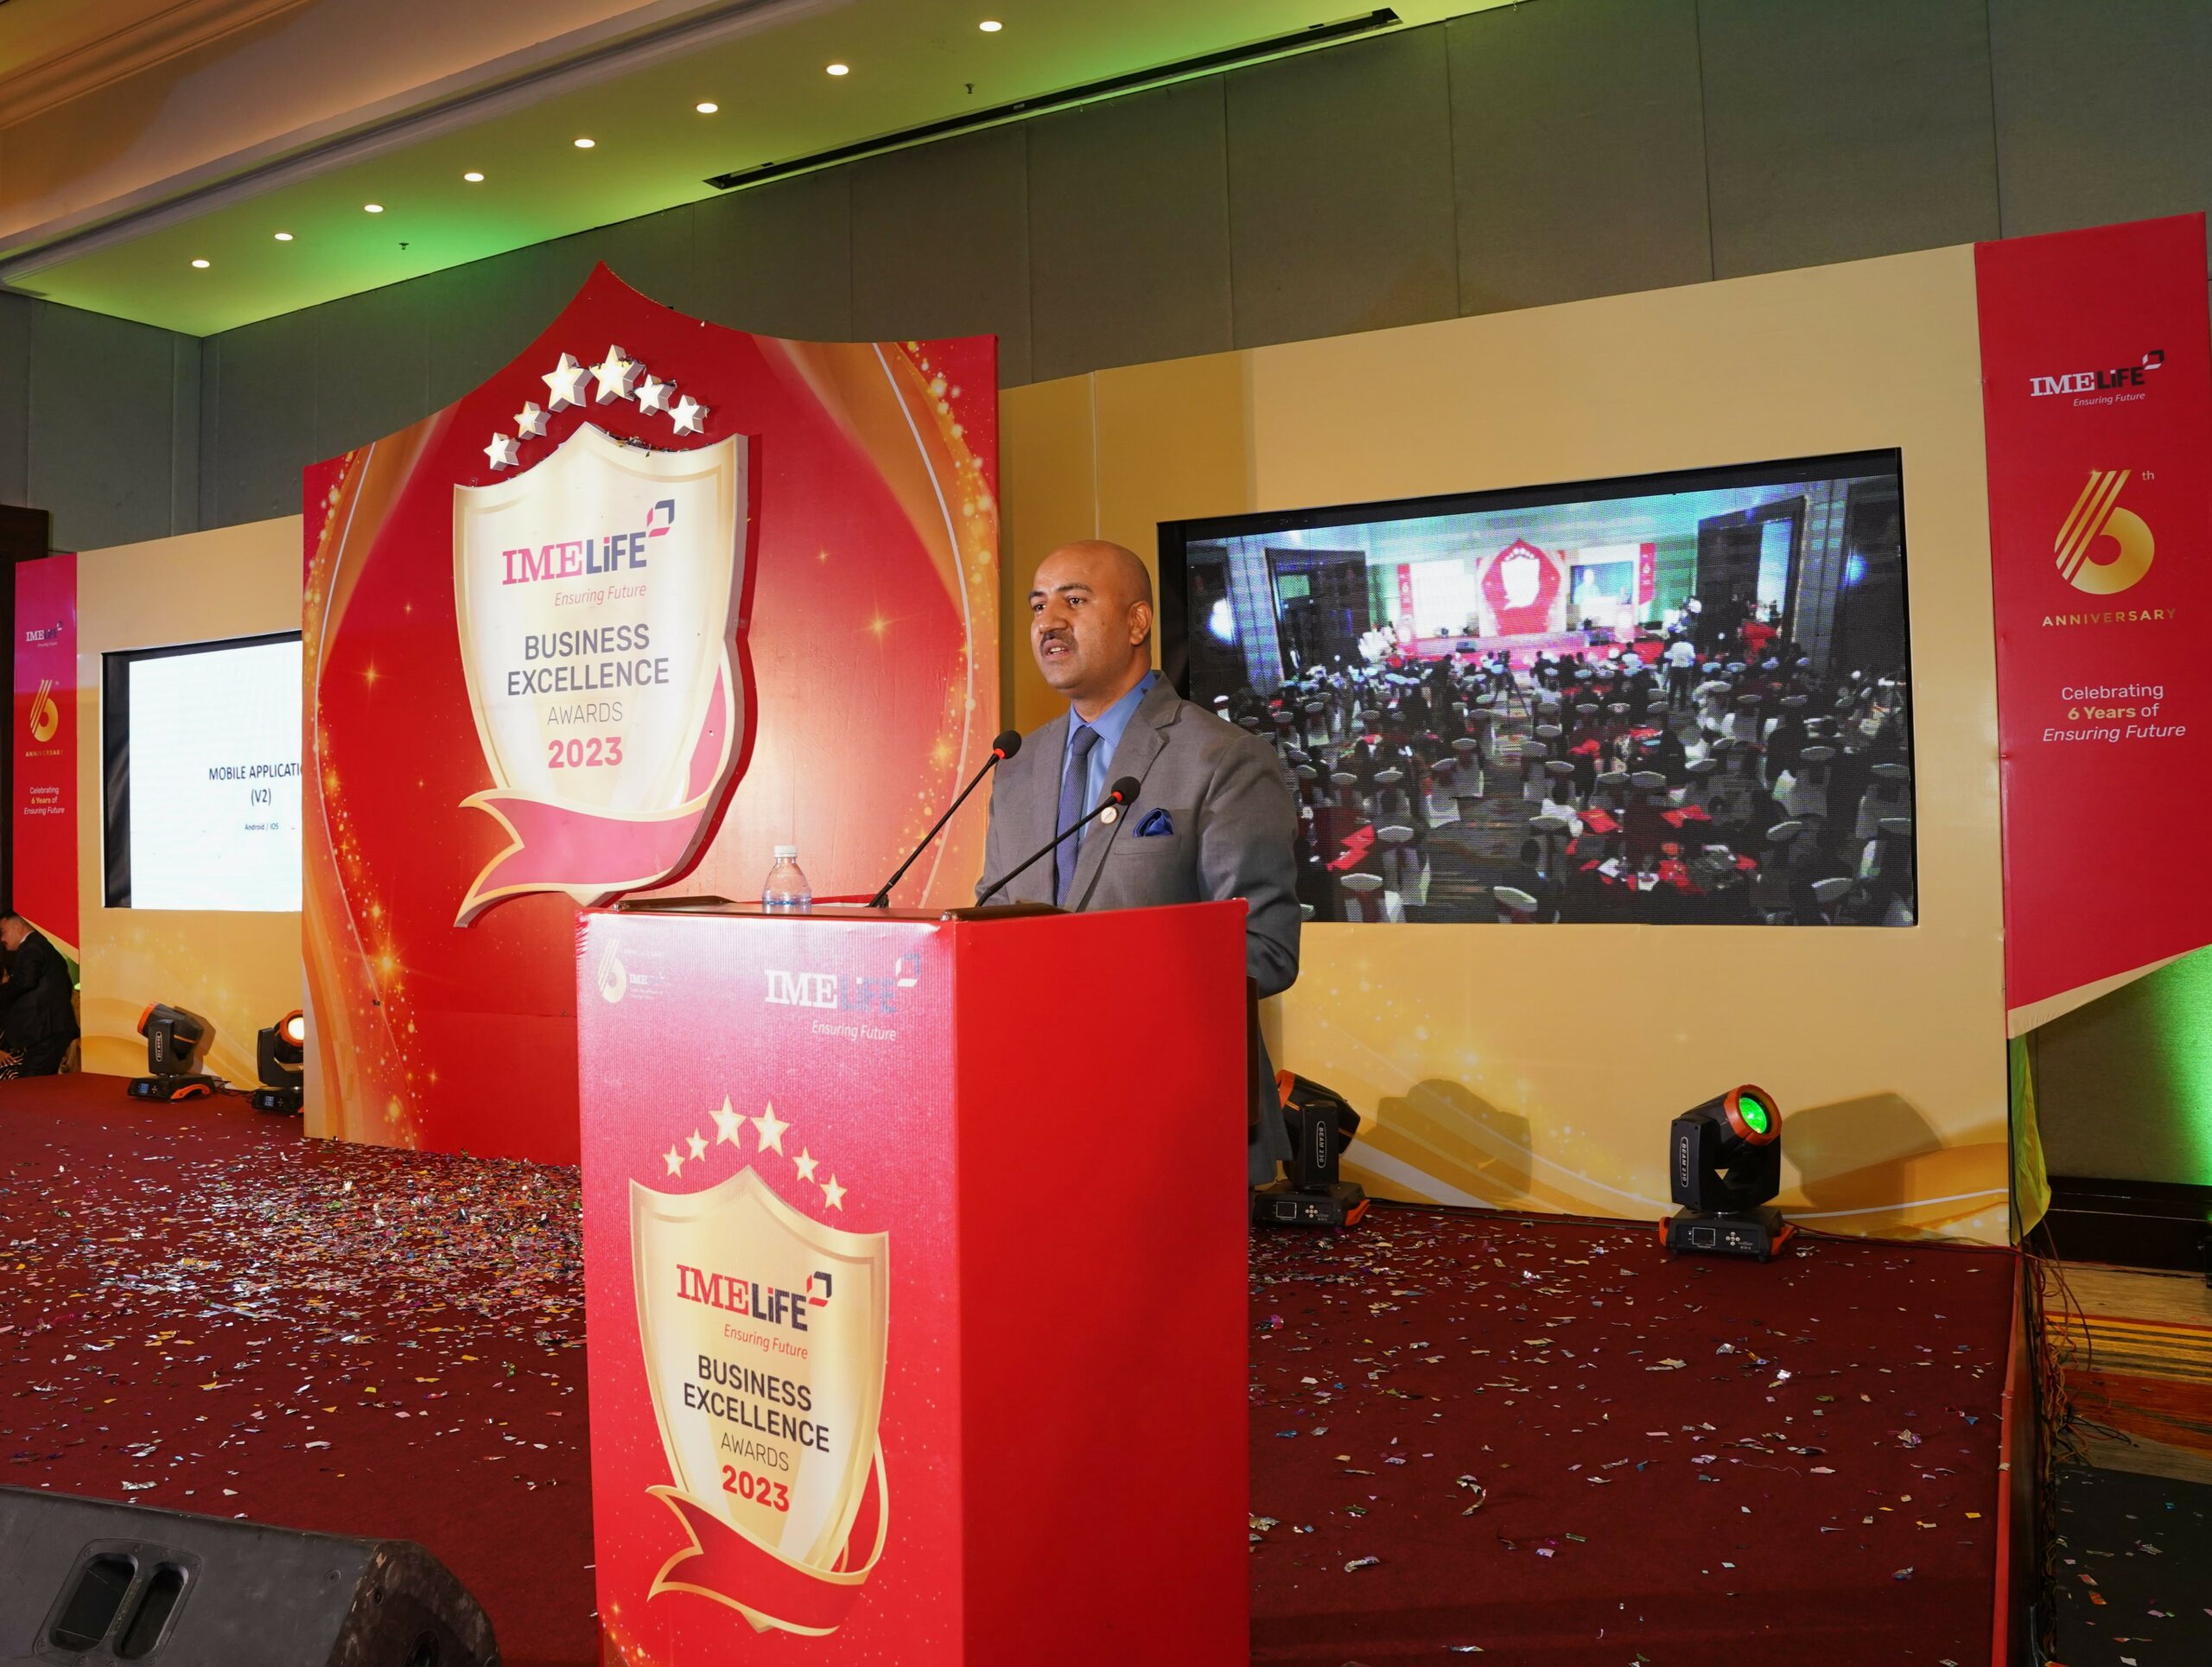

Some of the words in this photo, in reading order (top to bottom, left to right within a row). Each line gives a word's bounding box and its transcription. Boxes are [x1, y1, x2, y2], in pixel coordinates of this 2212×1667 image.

[2073, 395, 2113, 406] Ensuring
[2115, 391, 2145, 403] Future
[2054, 468, 2155, 595] 6
[554, 589, 604, 607] Ensuring
[607, 584, 647, 601] Future
[2042, 608, 2177, 627] ANNIVERSARY
[524, 623, 650, 660] BUSINESS
[507, 658, 670, 696] EXCELLENCE
[2062, 684, 2164, 701] Celebrating
[547, 701, 623, 726] AWARDS
[2067, 707, 2080, 721] 6
[2083, 706, 2136, 720] Years
[2140, 703, 2159, 717] of
[2043, 726, 2120, 743] Ensuring
[2125, 724, 2186, 738] Future
[548, 736, 623, 768] 2023
[209, 766, 246, 780] MOBILE
[29, 786, 60, 795] Celebrating
[251, 788, 271, 806] (V2)
[24, 807, 47, 816] Ensuring
[812, 1020, 857, 1041] Ensuring
[861, 1024, 896, 1041] Future
[724, 1324, 769, 1352] Ensuring
[772, 1337, 808, 1359] Future
[698, 1354, 812, 1411] BUSINESS
[684, 1383, 830, 1453] EXCELLENCE
[721, 1432, 789, 1472] AWARDS
[721, 1464, 790, 1512] 2023
